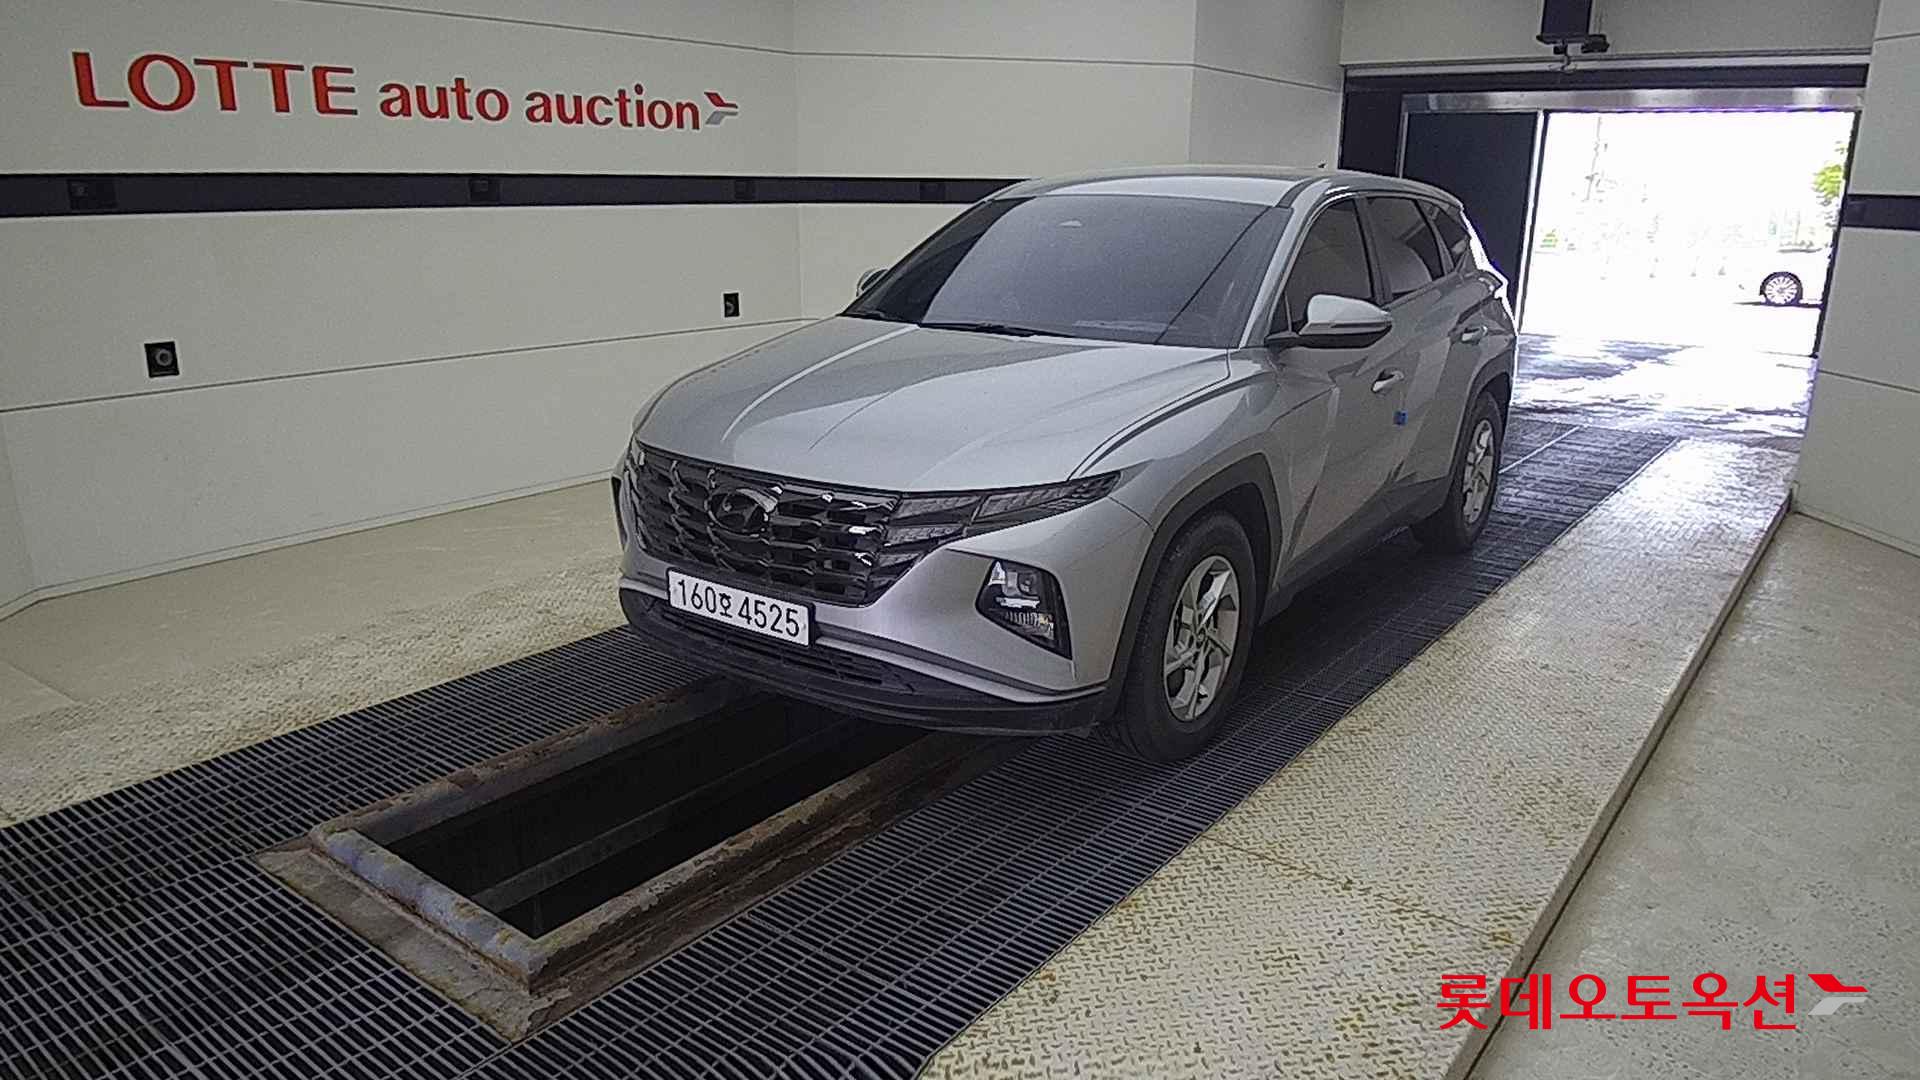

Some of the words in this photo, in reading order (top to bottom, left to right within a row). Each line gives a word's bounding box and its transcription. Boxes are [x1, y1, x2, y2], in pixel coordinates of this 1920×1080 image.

[72, 51, 359, 116] LOTTE
[379, 77, 510, 123] auto
[524, 84, 700, 131] auction
[677, 579, 733, 619] 160호
[738, 596, 800, 637] 4525
